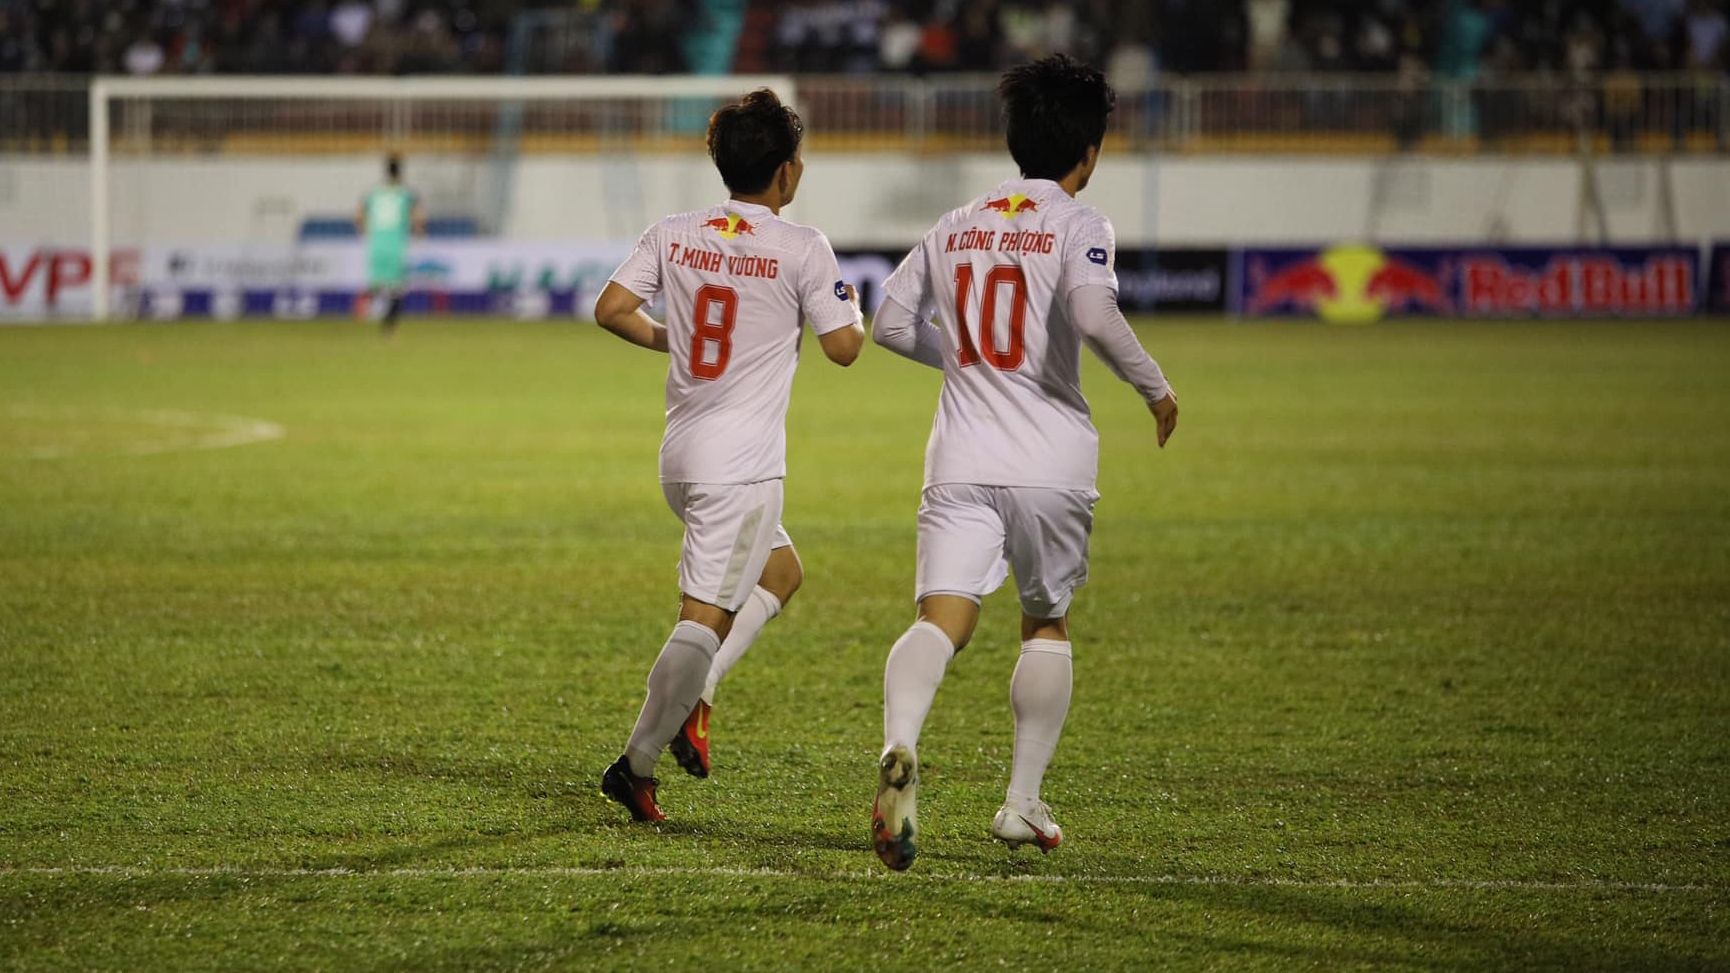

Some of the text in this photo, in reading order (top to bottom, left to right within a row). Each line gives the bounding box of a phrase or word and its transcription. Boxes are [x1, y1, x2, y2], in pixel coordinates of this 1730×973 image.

[689, 283, 740, 382] 8
[954, 262, 1028, 372] 10
[1463, 255, 1692, 312] Red Bull
